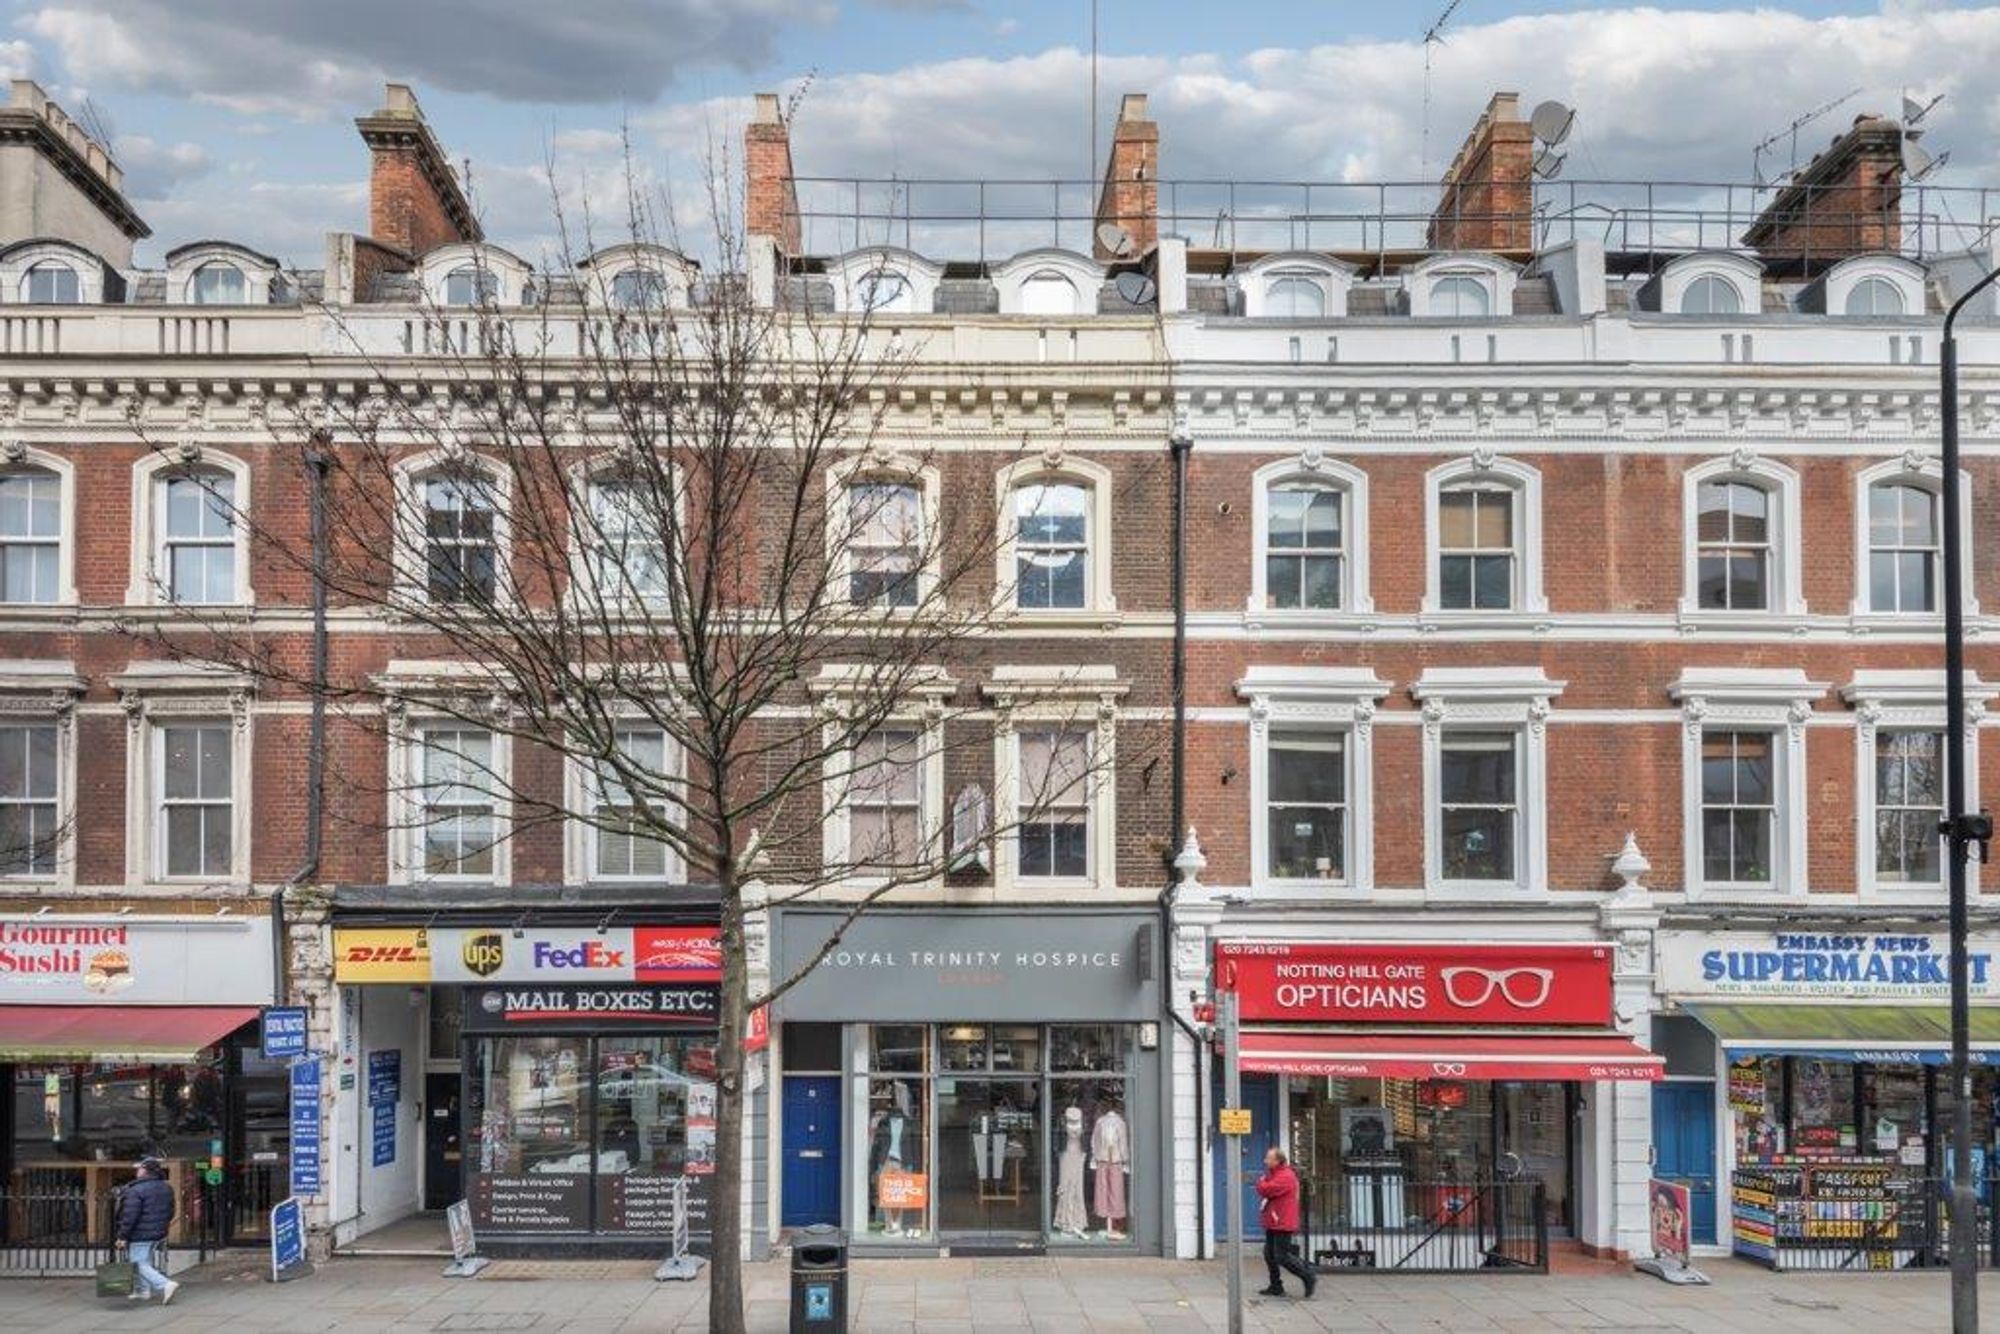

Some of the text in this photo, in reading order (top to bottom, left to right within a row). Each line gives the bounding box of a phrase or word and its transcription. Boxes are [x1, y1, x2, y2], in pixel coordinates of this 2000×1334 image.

[0, 921, 126, 944] Gourmet
[1776, 935, 1931, 952] EMBASSY NEWS
[0, 949, 80, 973] Sushi
[348, 947, 416, 962] DHL
[466, 945, 500, 971] ups
[534, 942, 624, 968] FedEx
[822, 951, 1121, 967] ROYAL TRINITY HOSPICE
[1277, 964, 1425, 980] NOTTING HILL GATE
[1702, 951, 1992, 984] SUPERMARKT
[505, 991, 570, 1011] MAIL
[576, 991, 654, 1011] BOXES
[1277, 984, 1427, 1009] OPTICIANS
